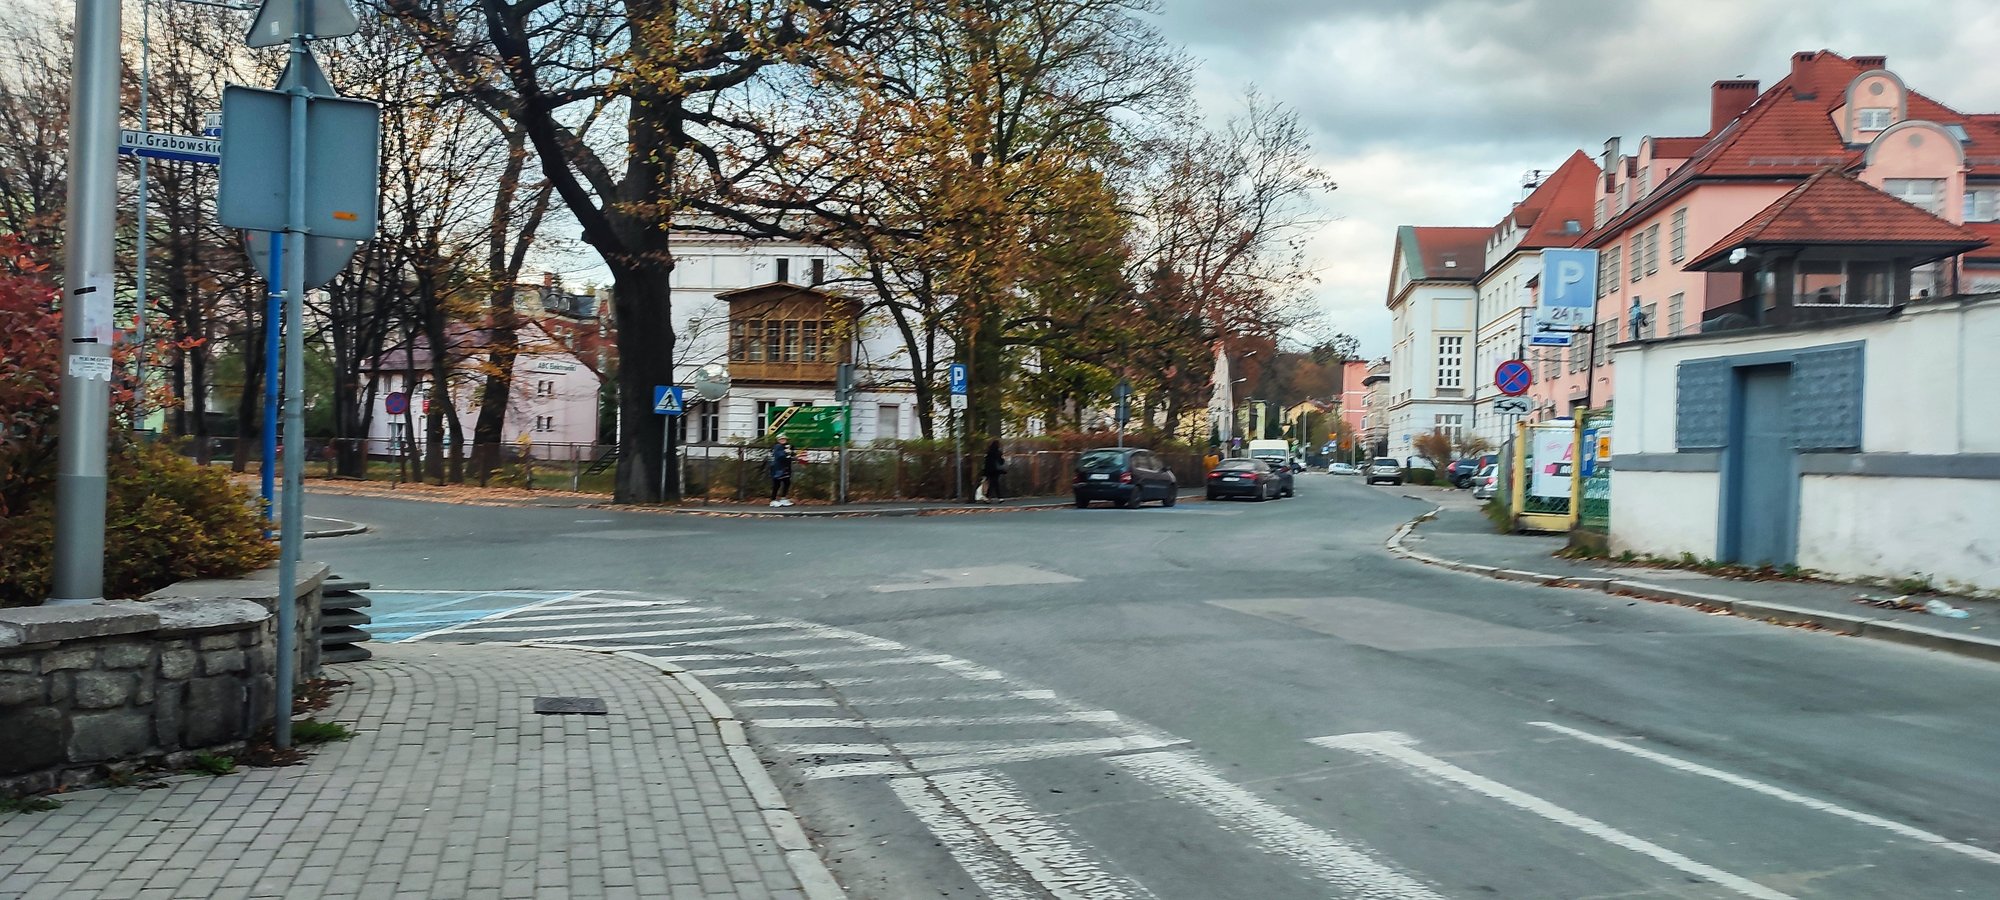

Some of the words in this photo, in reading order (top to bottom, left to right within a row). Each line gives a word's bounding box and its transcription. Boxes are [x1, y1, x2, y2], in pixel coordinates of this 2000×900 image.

[126, 133, 143, 145] ul.
[1554, 260, 1585, 301] P
[1552, 307, 1568, 320] 24
[537, 362, 549, 370] ABC
[953, 366, 964, 386] P
